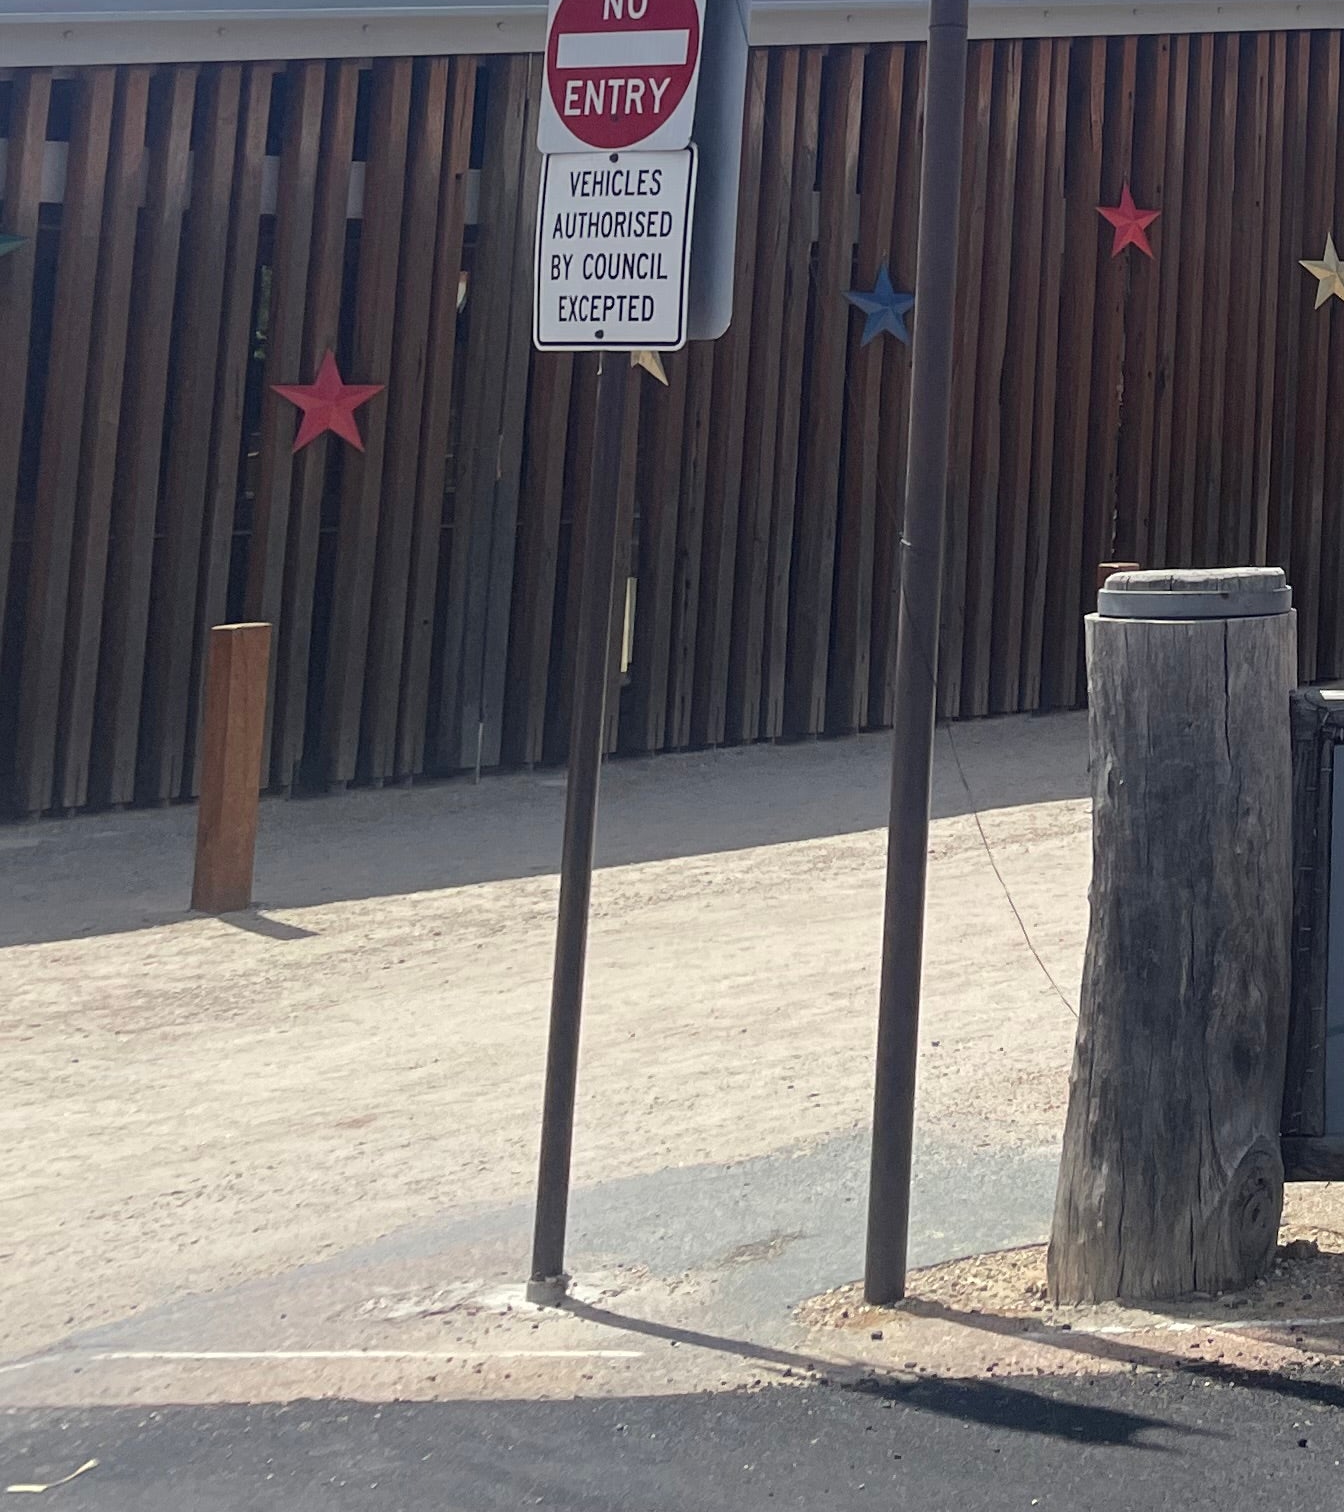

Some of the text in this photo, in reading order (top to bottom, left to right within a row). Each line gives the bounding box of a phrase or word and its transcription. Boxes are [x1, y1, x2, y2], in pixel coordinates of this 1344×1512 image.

[564, 77, 672, 116] ENTRY
[570, 169, 662, 197] VEHICLES
[552, 211, 673, 239] AUTHORISED
[551, 253, 668, 280] BY COUNCIL
[558, 295, 654, 322] EXCEPTED
